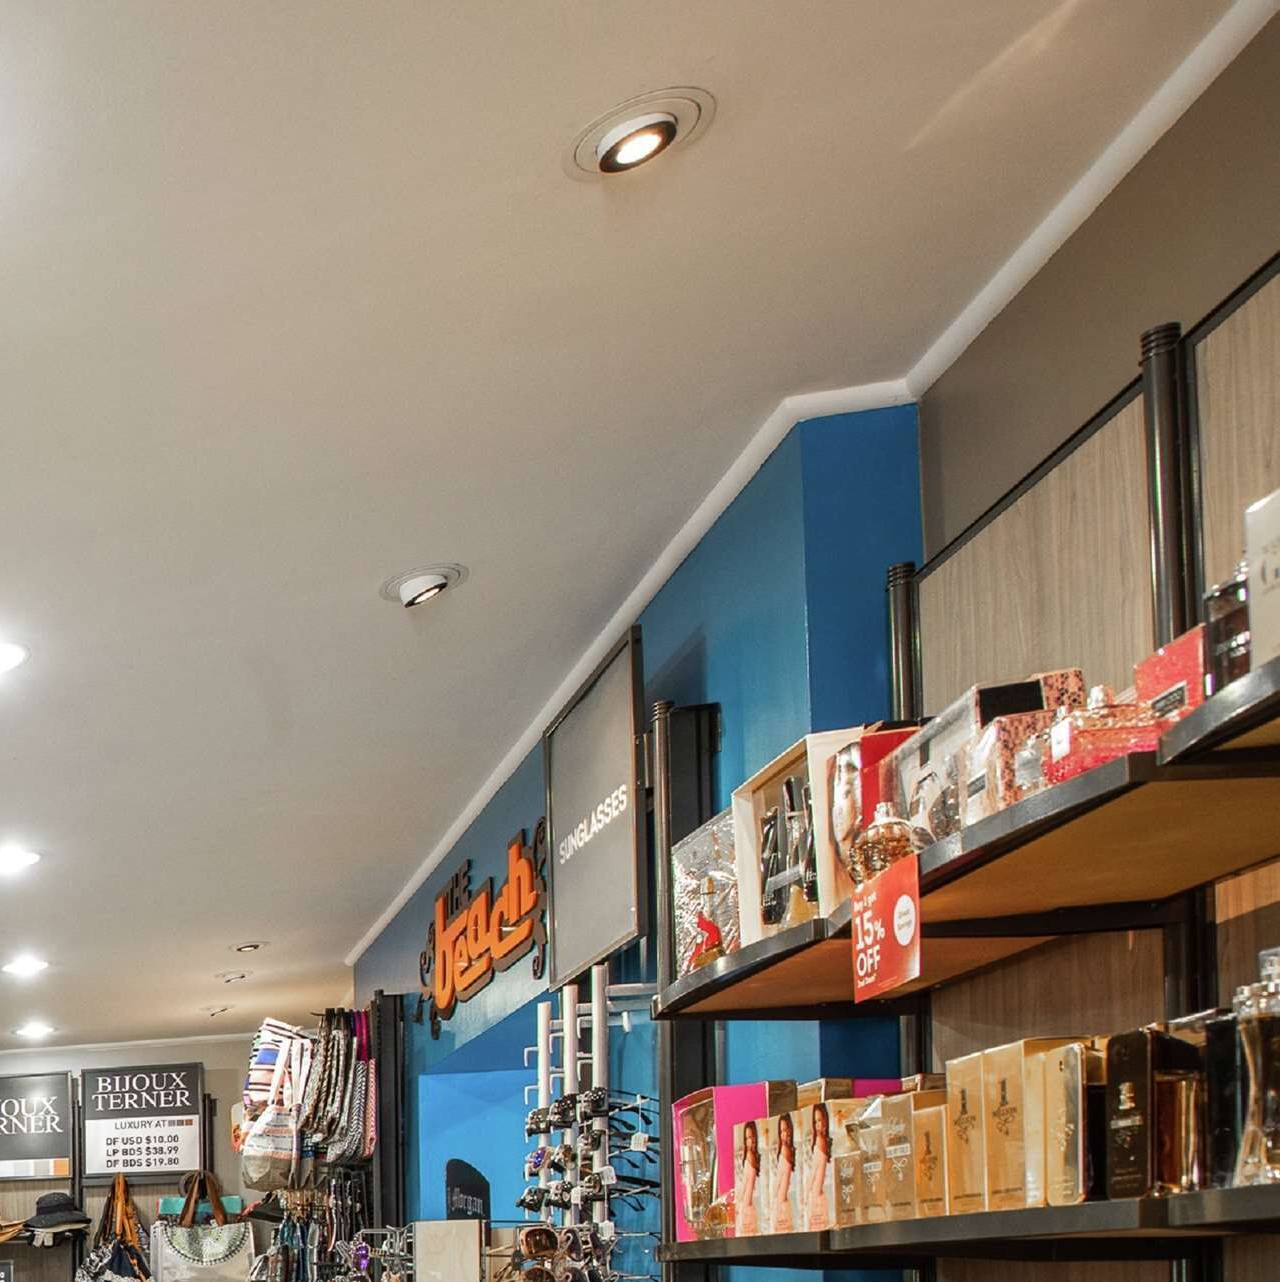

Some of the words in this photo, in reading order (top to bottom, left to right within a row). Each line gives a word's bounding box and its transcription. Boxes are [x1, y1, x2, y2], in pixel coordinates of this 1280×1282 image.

[559, 784, 627, 864] SUNGLASSES
[434, 842, 539, 1010] beach
[857, 945, 880, 976] OFF
[97, 1072, 188, 1094] BIJOUX
[92, 1090, 191, 1111] TERNER
[115, 1121, 152, 1130] LUXURY
[153, 1120, 167, 1129] AT
[106, 1137, 120, 1146] DF
[122, 1136, 142, 1145] USD
[145, 1134, 179, 1144] $10.00
[106, 1149, 120, 1157] LP
[122, 1147, 143, 1156] BDS
[145, 1146, 179, 1156] $38.99
[106, 1159, 120, 1168] DF
[122, 1158, 143, 1168] BDS
[145, 1157, 179, 1167] $19.80
